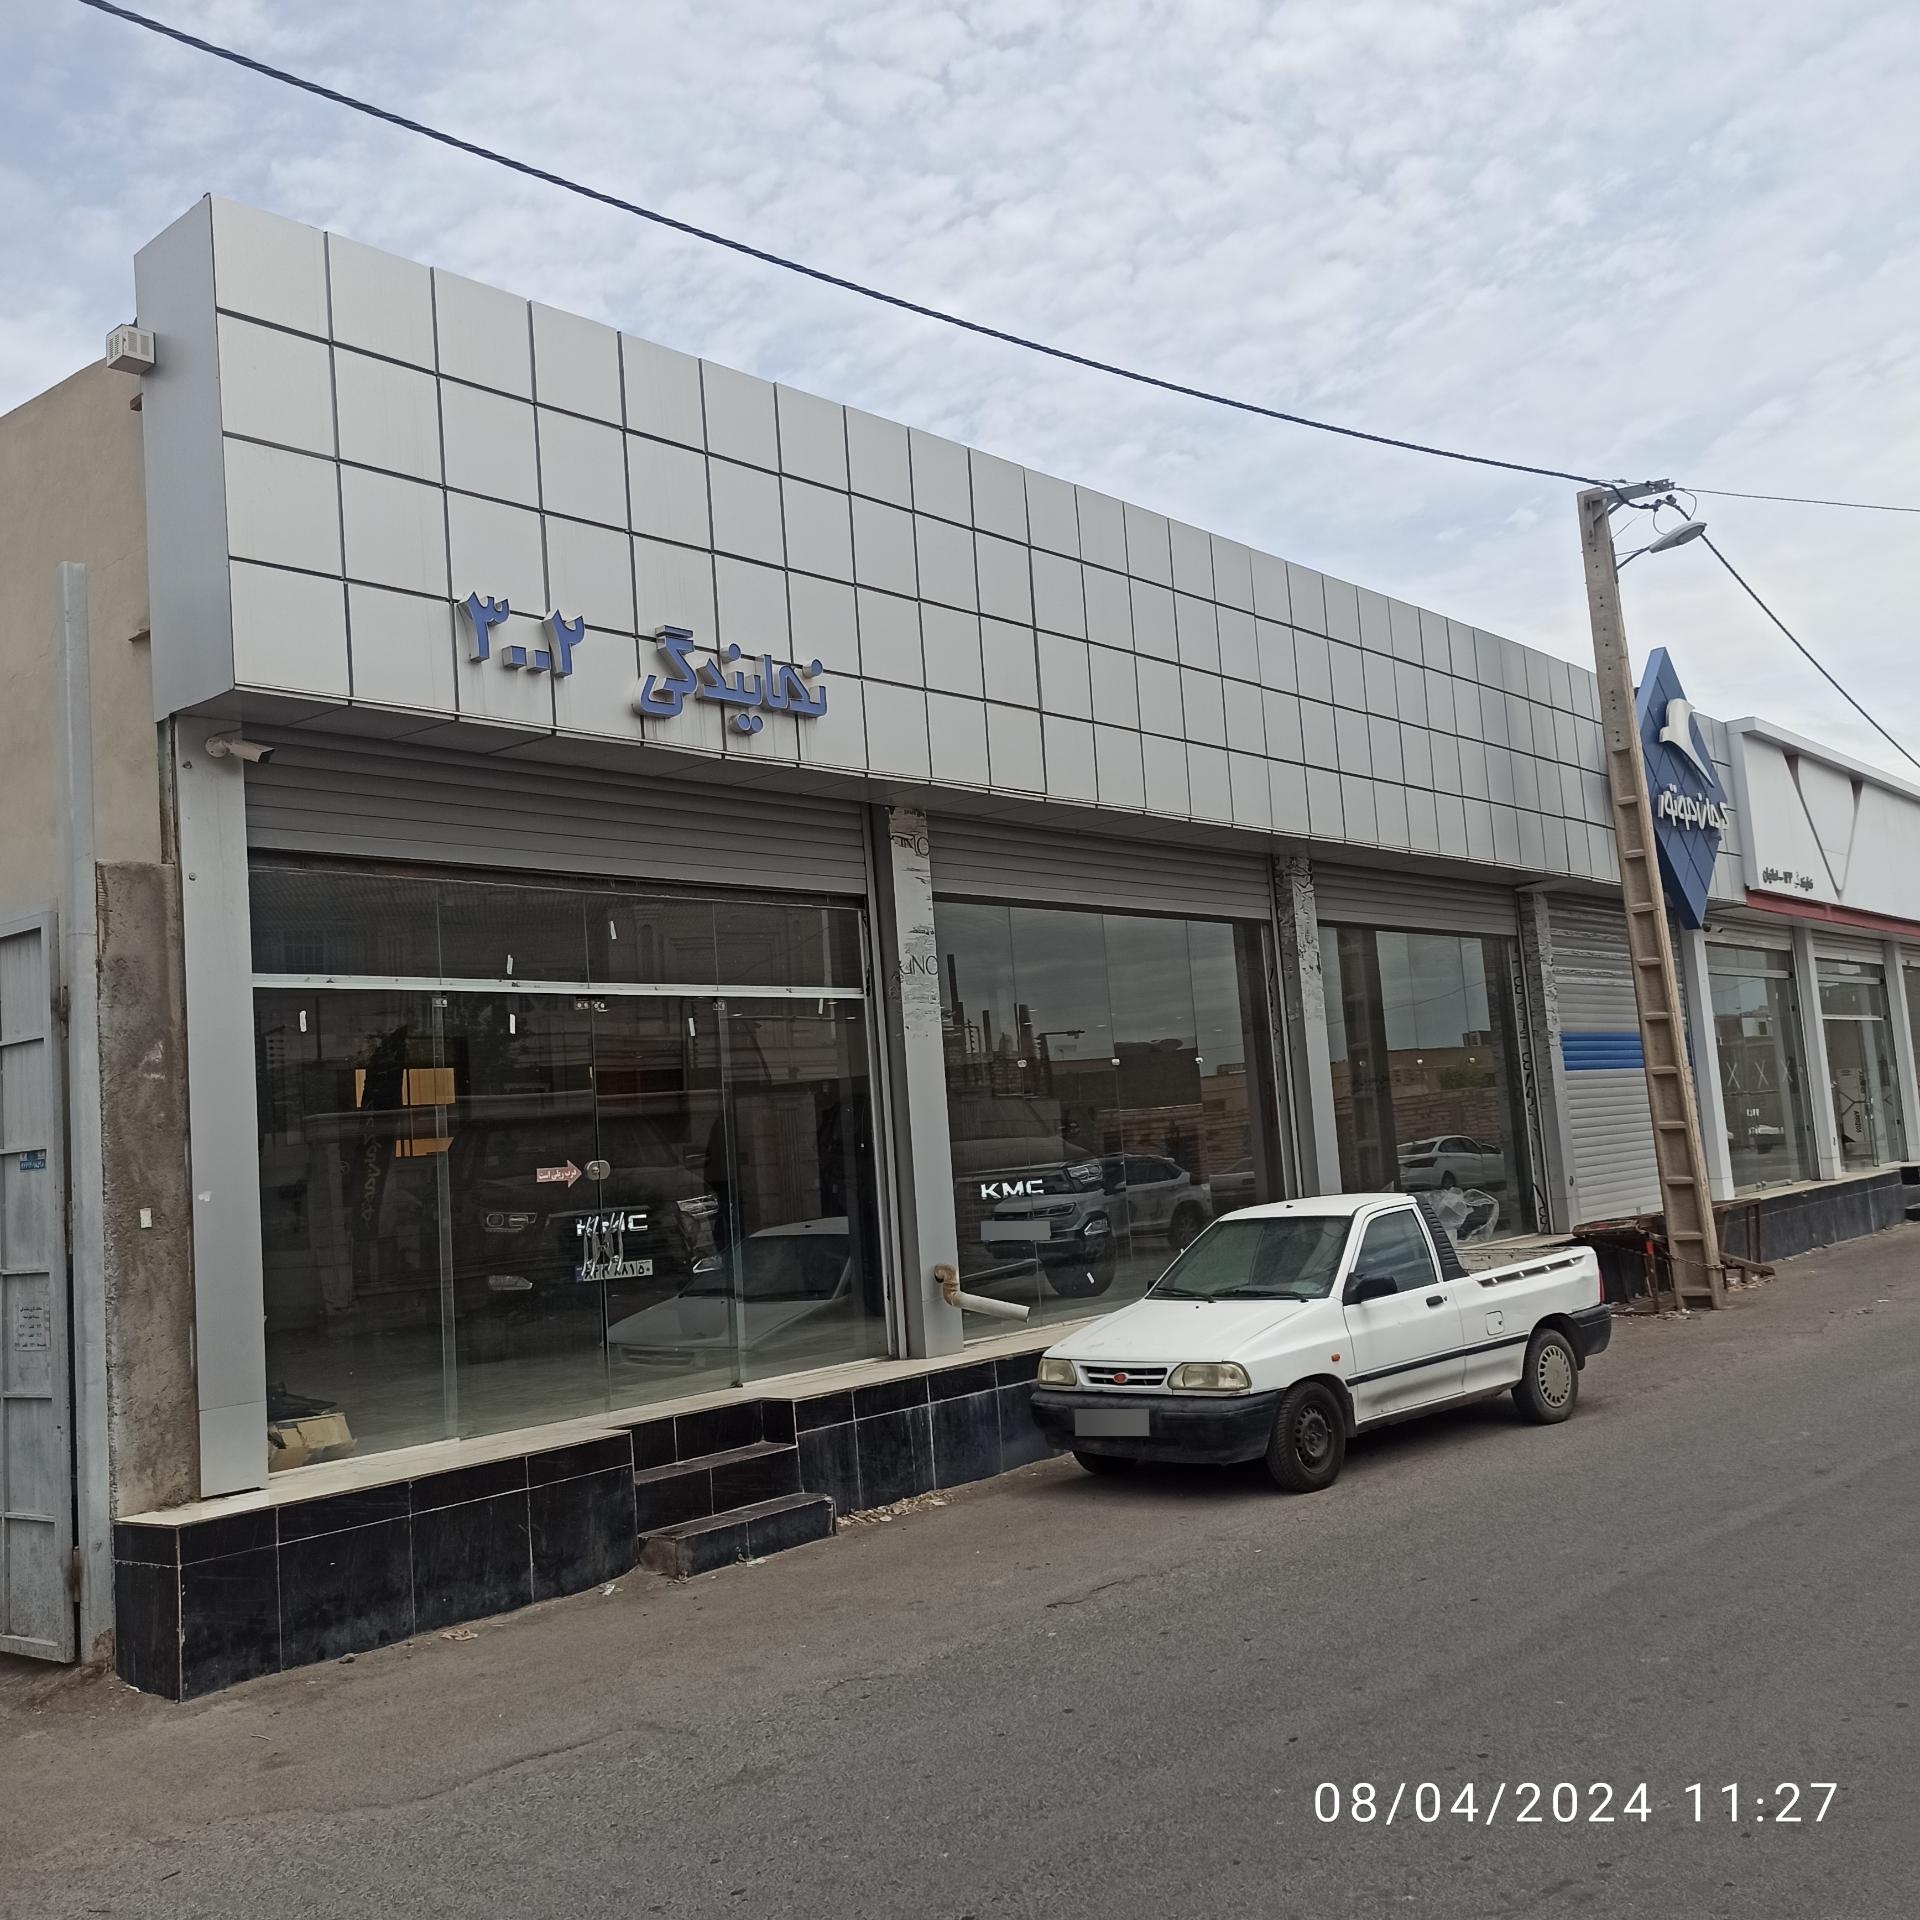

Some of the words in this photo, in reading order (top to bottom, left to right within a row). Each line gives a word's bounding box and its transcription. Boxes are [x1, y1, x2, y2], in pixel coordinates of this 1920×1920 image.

[632, 624, 828, 735] نمایندگی
[538, 1170, 551, 1179] است
[564, 1169, 577, 1179] درب
[980, 1178, 1044, 1200] KMC
